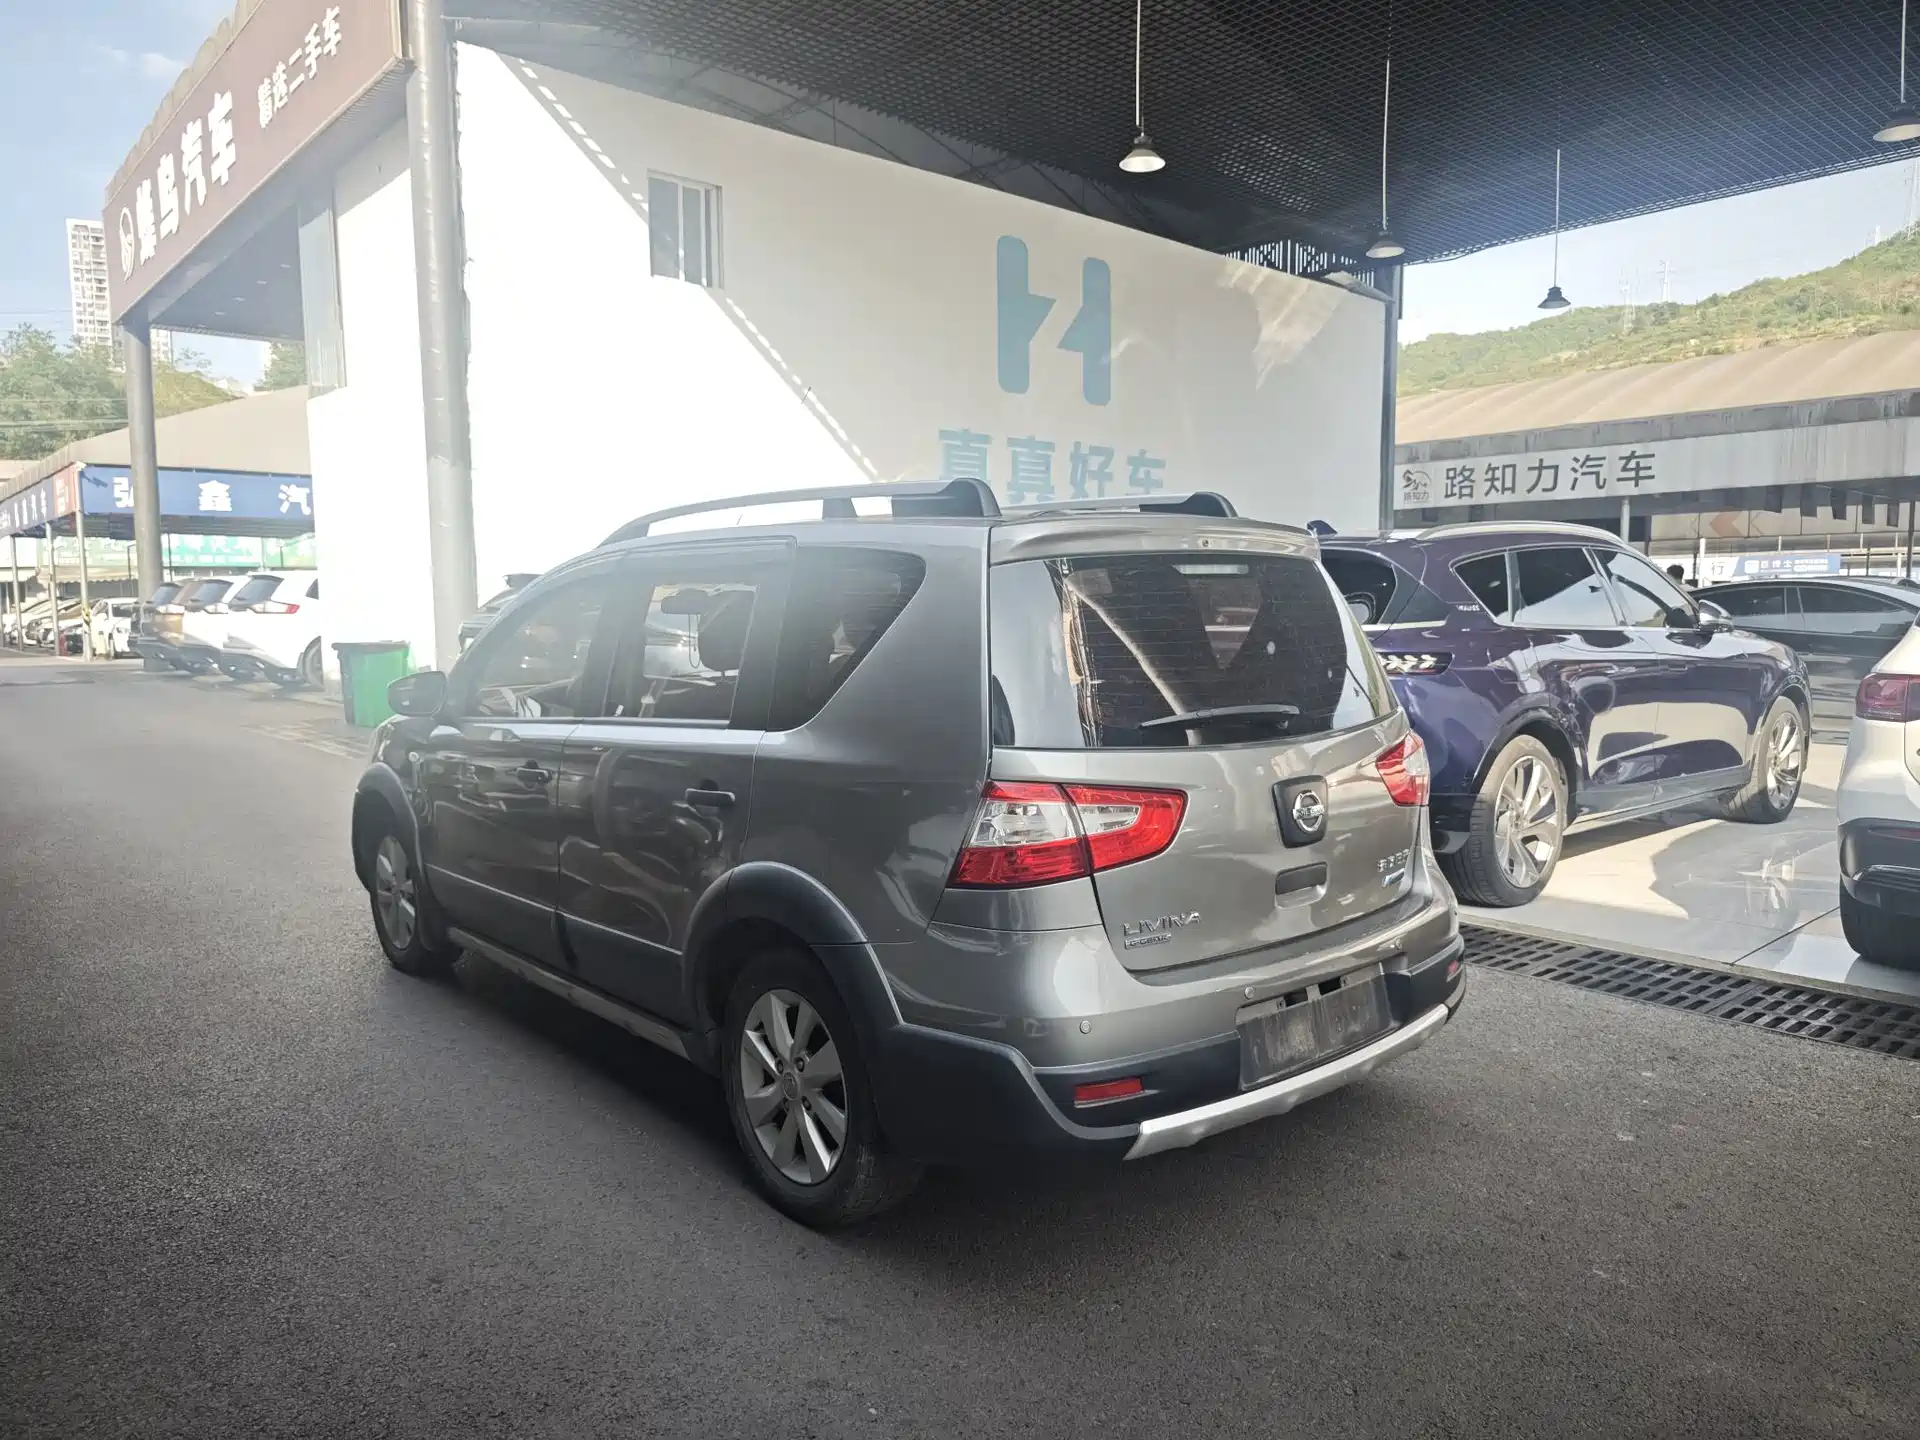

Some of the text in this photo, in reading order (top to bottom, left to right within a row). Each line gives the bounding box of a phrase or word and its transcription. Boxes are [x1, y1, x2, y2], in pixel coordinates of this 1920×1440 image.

[1444, 450, 1656, 500] 路知力汽车
[1122, 912, 1200, 937] LIVINA
